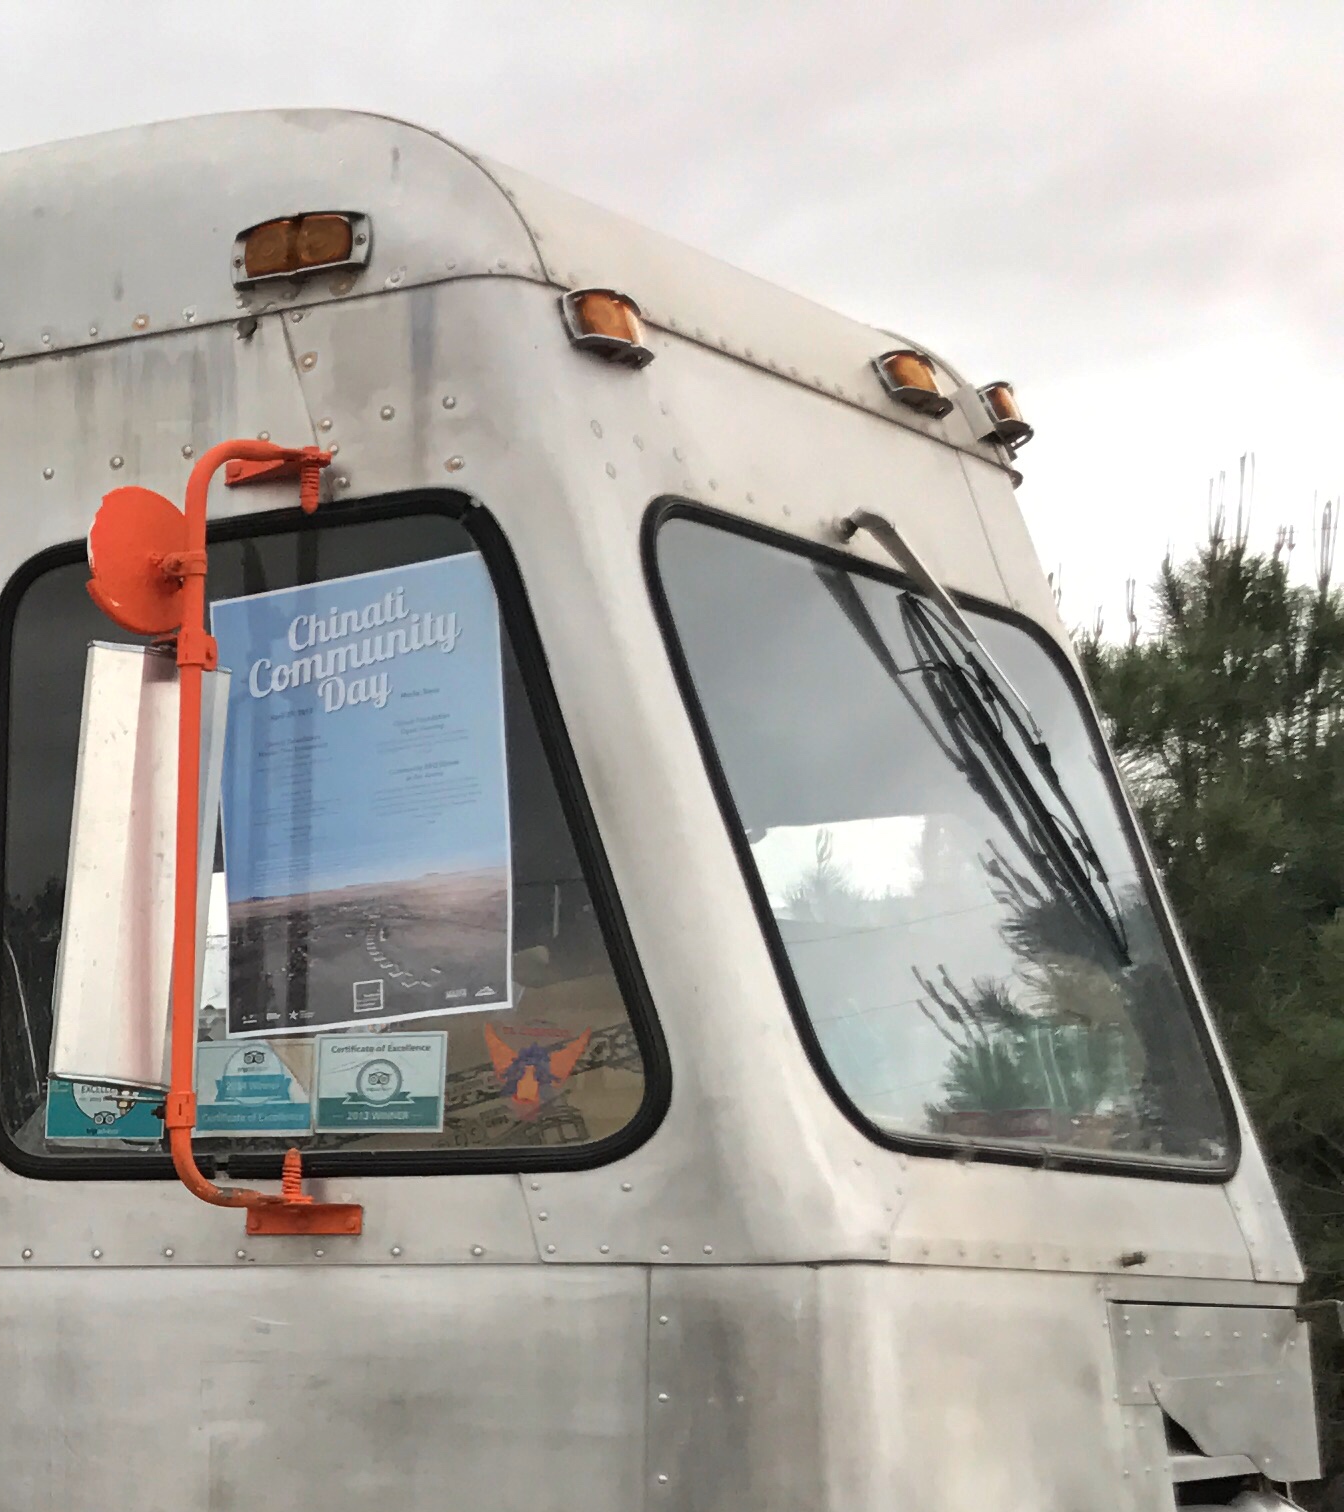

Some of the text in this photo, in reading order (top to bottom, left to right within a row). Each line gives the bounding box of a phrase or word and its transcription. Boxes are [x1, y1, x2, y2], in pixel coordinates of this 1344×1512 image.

[288, 586, 410, 651] Chinati
[248, 611, 462, 698] Community
[317, 671, 392, 713] Day
[331, 1044, 375, 1054] Certificate
[387, 1043, 432, 1053] Excellence
